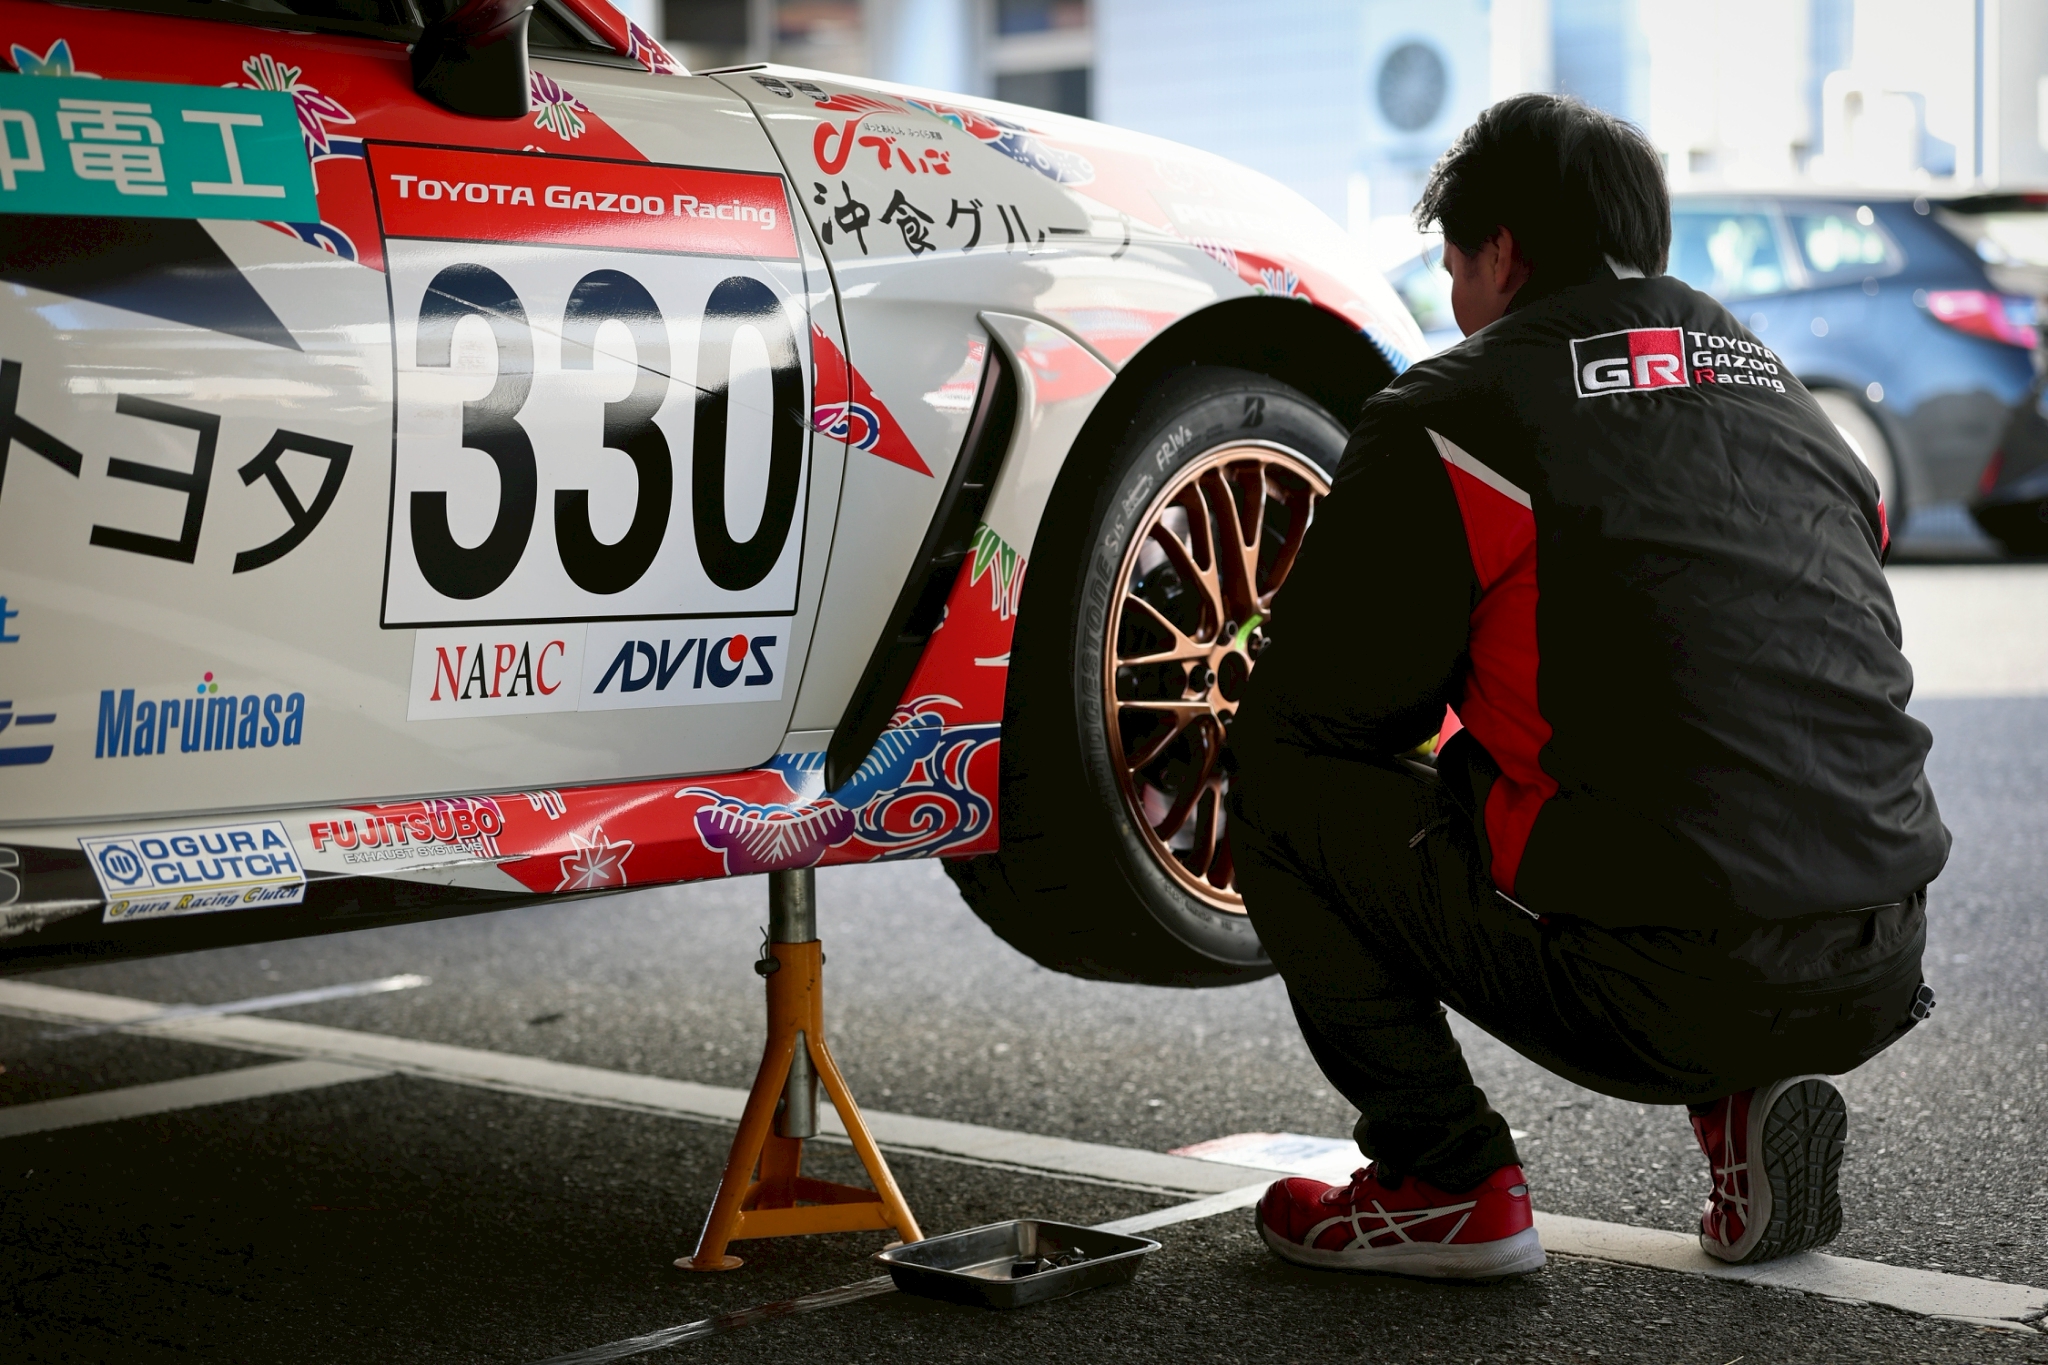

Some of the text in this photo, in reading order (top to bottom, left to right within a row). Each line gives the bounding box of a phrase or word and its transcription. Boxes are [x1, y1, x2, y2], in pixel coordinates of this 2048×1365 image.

[390, 174, 777, 231] TOYOTA GAZOO Racing
[1687, 331, 1777, 362] TOYOTA
[1692, 350, 1778, 376] GAZOO
[1582, 353, 1684, 391] GR
[1694, 368, 1786, 394] Racing
[410, 262, 805, 601] 330
[0, 359, 354, 575] トヨタ
[430, 640, 565, 702] NAPAC
[593, 634, 777, 694] ADVICS
[95, 687, 306, 759] Marumasa
[139, 828, 287, 860] OGURA
[308, 807, 503, 853] FUJITSUBO
[151, 851, 298, 885] CLUTCH
[344, 842, 484, 865] EXHAUST SYSTEMS
[110, 887, 300, 918] Ogura Racing Clutch
